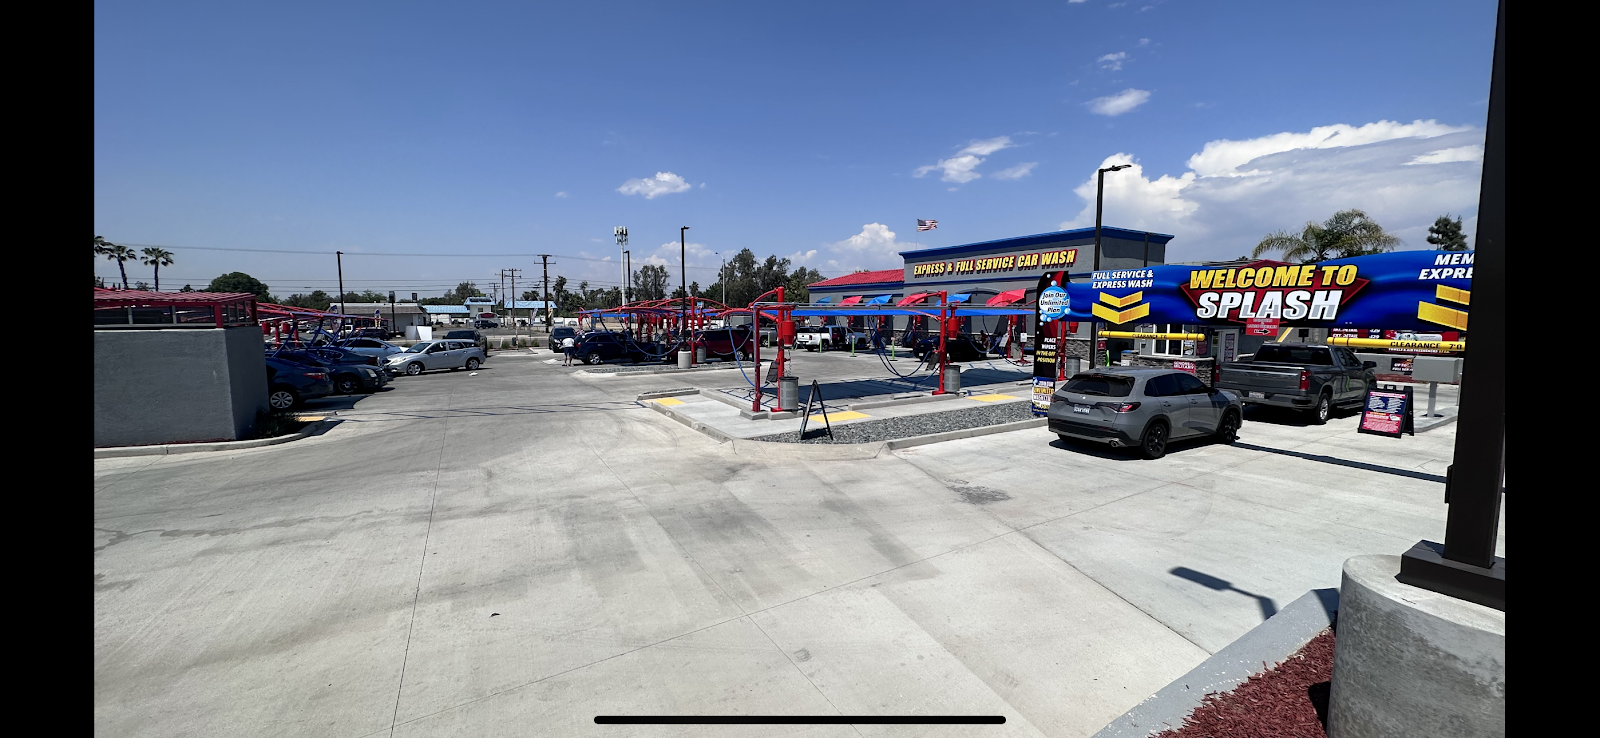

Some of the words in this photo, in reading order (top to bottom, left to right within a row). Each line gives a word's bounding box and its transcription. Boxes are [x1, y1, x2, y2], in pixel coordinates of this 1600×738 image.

[914, 264, 945, 275] EXPRESS
[947, 262, 953, 272] &
[955, 260, 975, 272] FULL
[976, 256, 1016, 270] SERVICE
[1017, 253, 1040, 267] CAR
[1041, 249, 1078, 265] WASH
[1434, 253, 1474, 265] MEM
[1092, 271, 1110, 280] FULL
[1111, 270, 1146, 279] SERVICE
[1146, 269, 1154, 278] &
[1190, 265, 1316, 288] WELCOME
[1322, 264, 1358, 286] TO
[1418, 267, 1473, 279] EXPRE
[1092, 280, 1127, 289] EXPRESS
[1128, 279, 1153, 288] WASH
[1197, 290, 1343, 320] SPLASH
